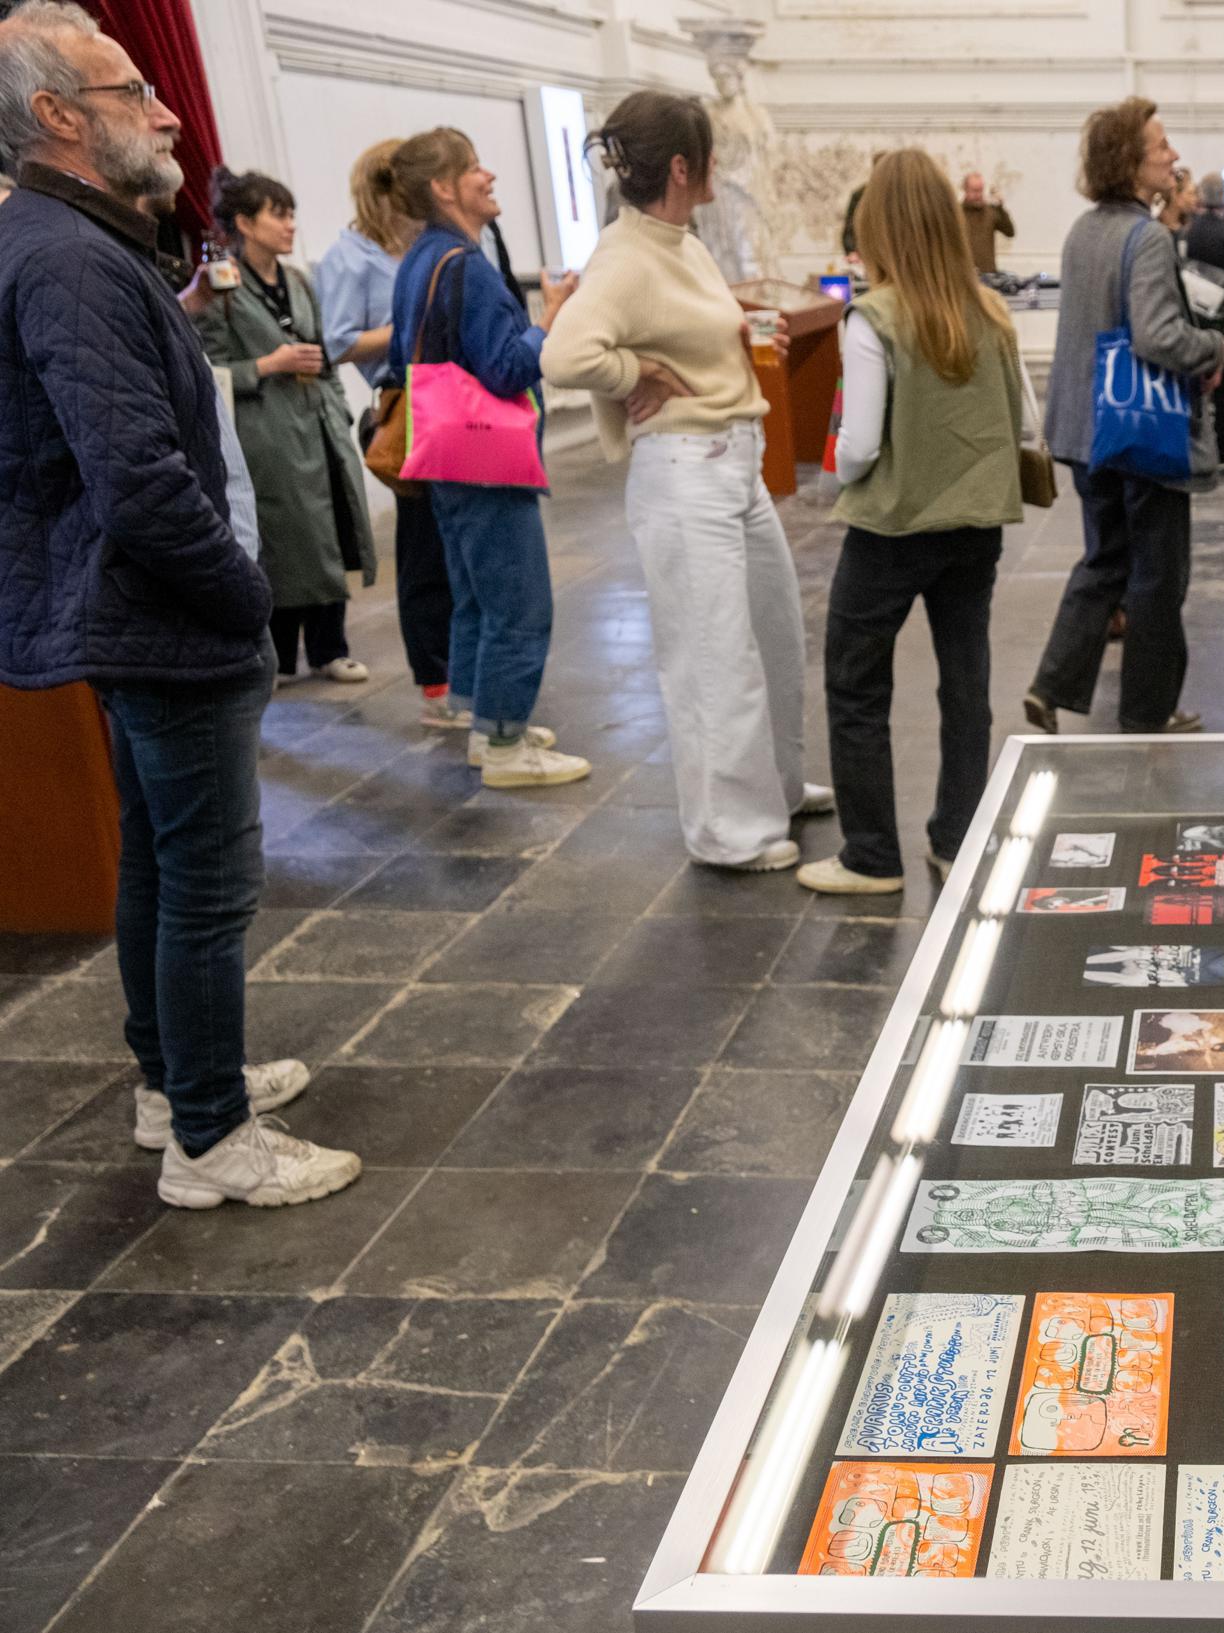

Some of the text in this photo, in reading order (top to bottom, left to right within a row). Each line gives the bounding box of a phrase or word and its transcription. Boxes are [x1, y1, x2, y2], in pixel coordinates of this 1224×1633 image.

[1103, 1123, 1119, 1163] CONTEST
[857, 1383, 894, 1453] AVARUS
[1079, 1501, 1106, 1536] juni
[1207, 1488, 1219, 1524] STURGEON
[1018, 1518, 1034, 1544] CRANK
[1080, 1539, 1097, 1555] 12
[1201, 1528, 1216, 1553] CRANK
